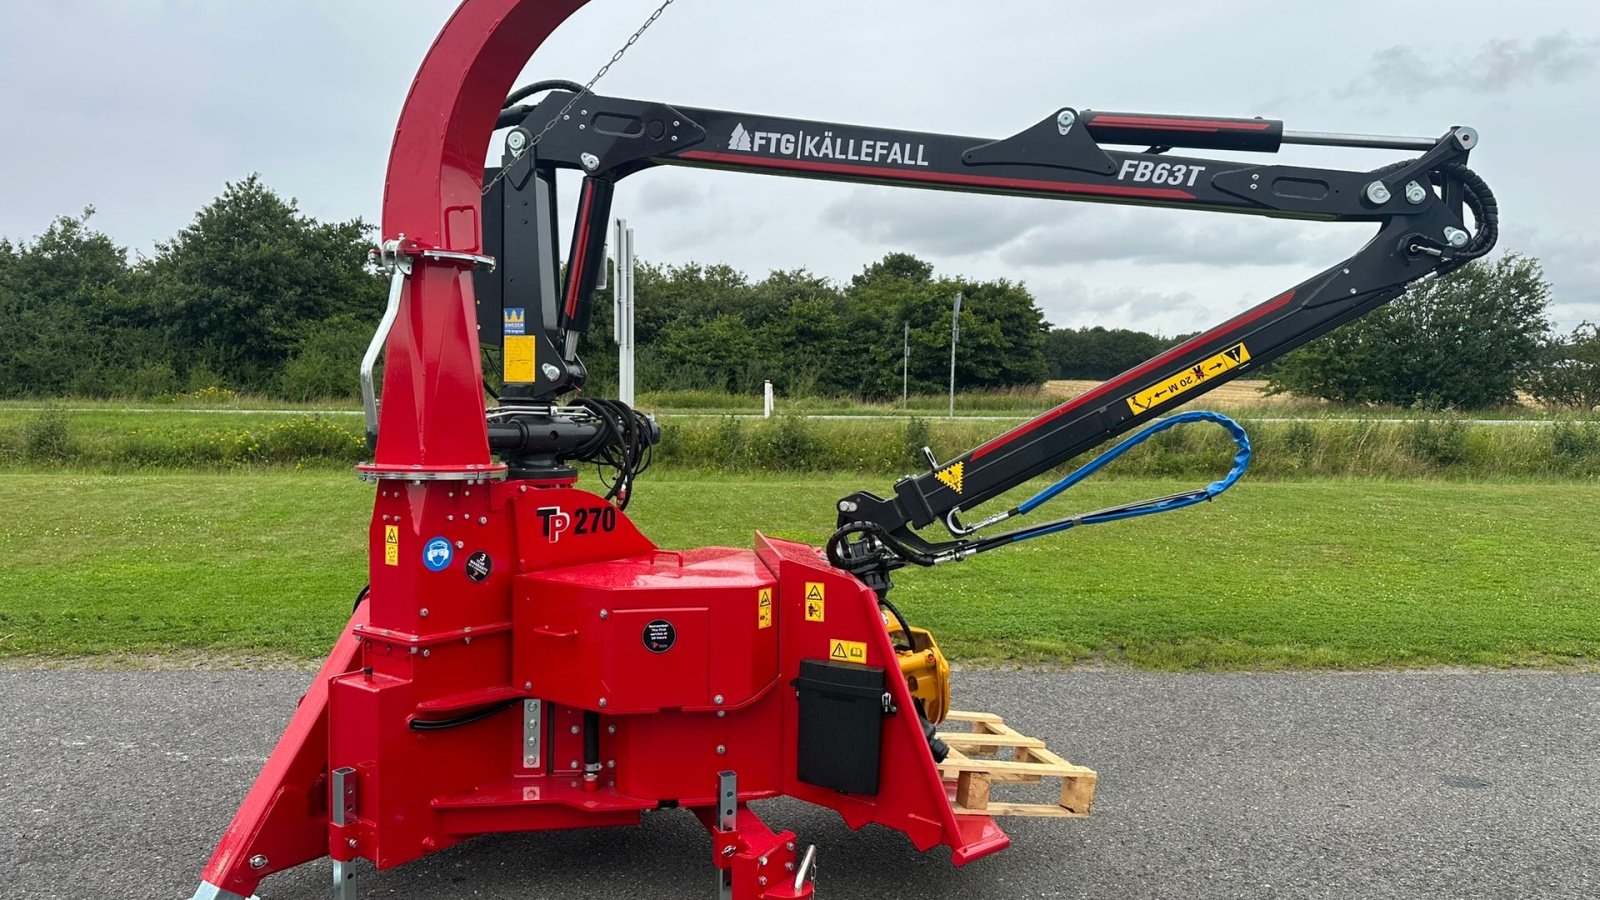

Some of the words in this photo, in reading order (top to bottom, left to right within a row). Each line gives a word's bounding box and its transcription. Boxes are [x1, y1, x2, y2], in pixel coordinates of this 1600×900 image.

[753, 131, 795, 155] FTG
[804, 131, 929, 166] KÄLLEFALL
[1117, 159, 1206, 187] FB63T
[1168, 383, 1179, 393] M
[1179, 375, 1193, 387] 20
[536, 506, 570, 544] TP
[574, 506, 616, 535] 270
[480, 553, 486, 561] 3
